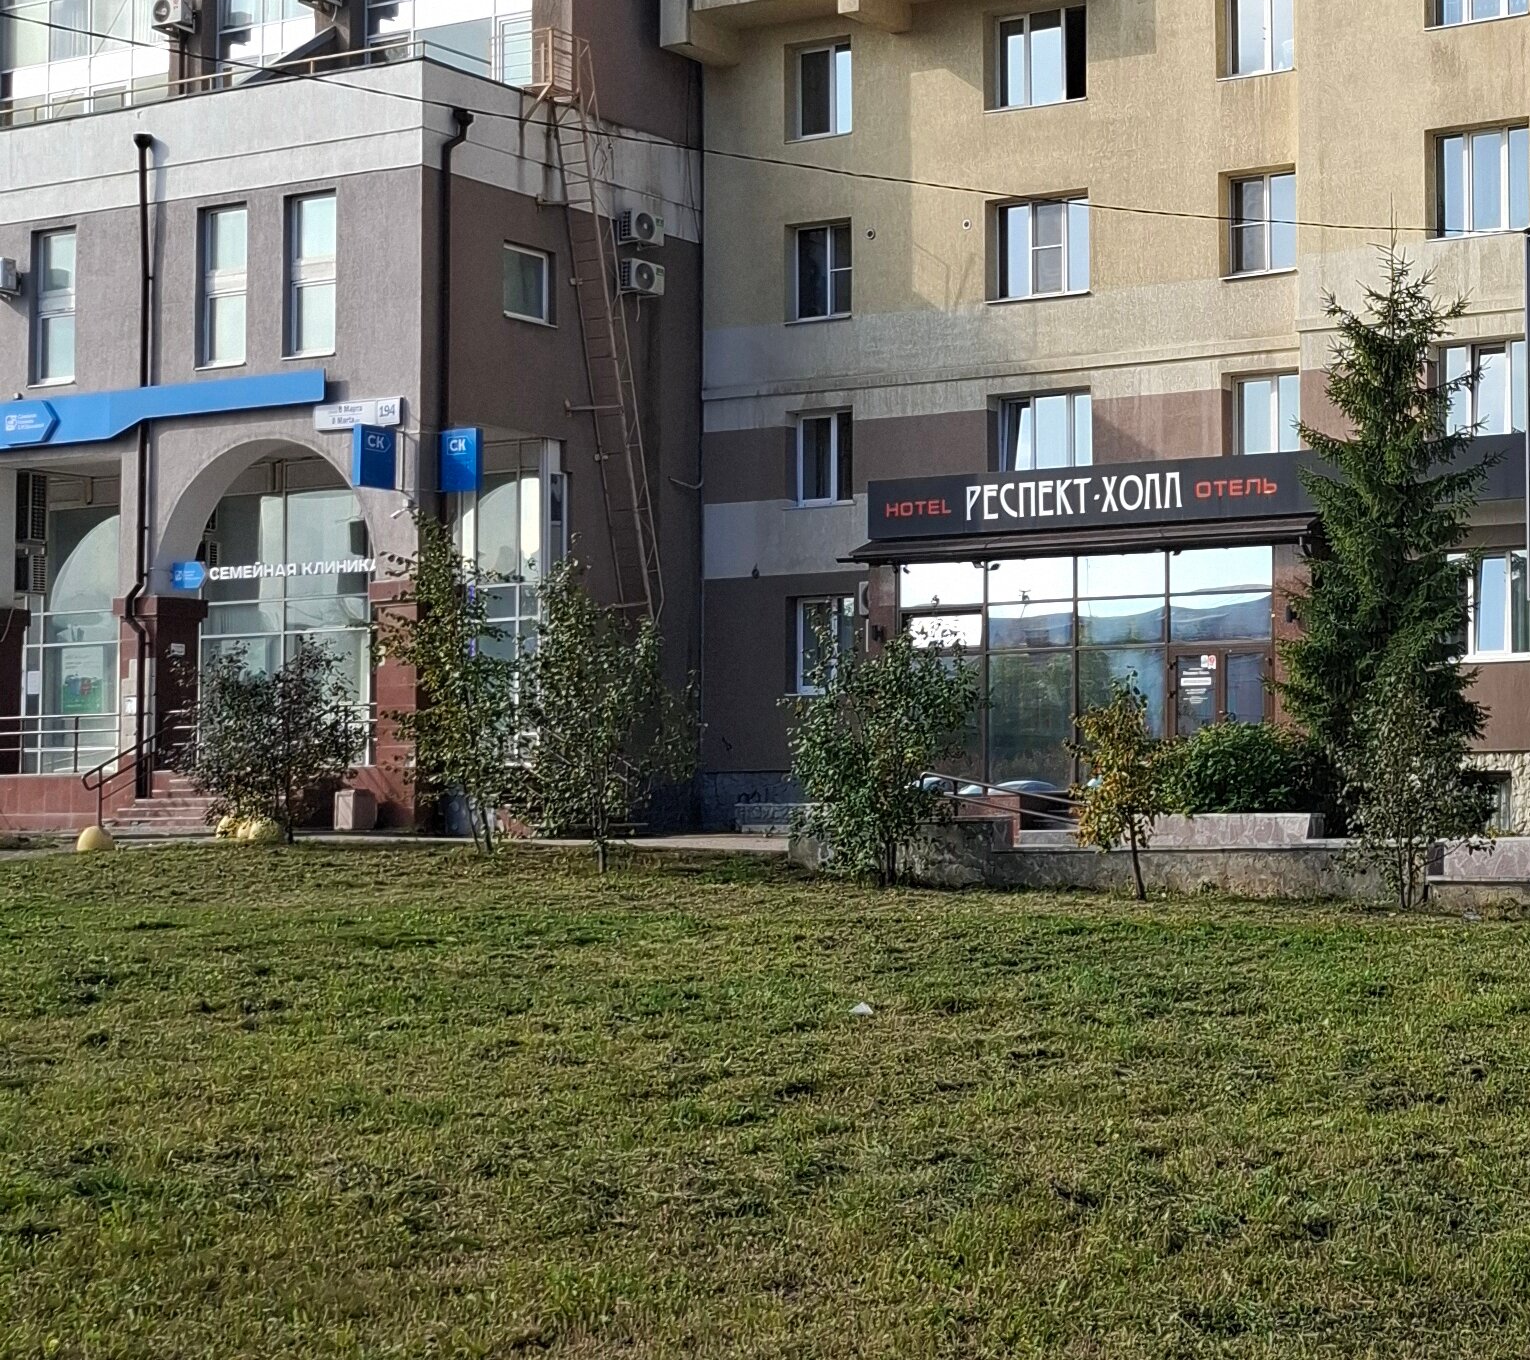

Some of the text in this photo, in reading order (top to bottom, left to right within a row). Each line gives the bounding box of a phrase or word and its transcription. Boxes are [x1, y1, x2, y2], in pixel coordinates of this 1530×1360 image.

[379, 403, 396, 418] 194
[367, 435, 385, 449] СК
[450, 440, 466, 451] СК
[886, 472, 1278, 520] HOTEL РЕСПЕКТ-ХОЛЛ ОТЕЛЬ
[209, 561, 297, 581] СЕМЕЙНАЯ
